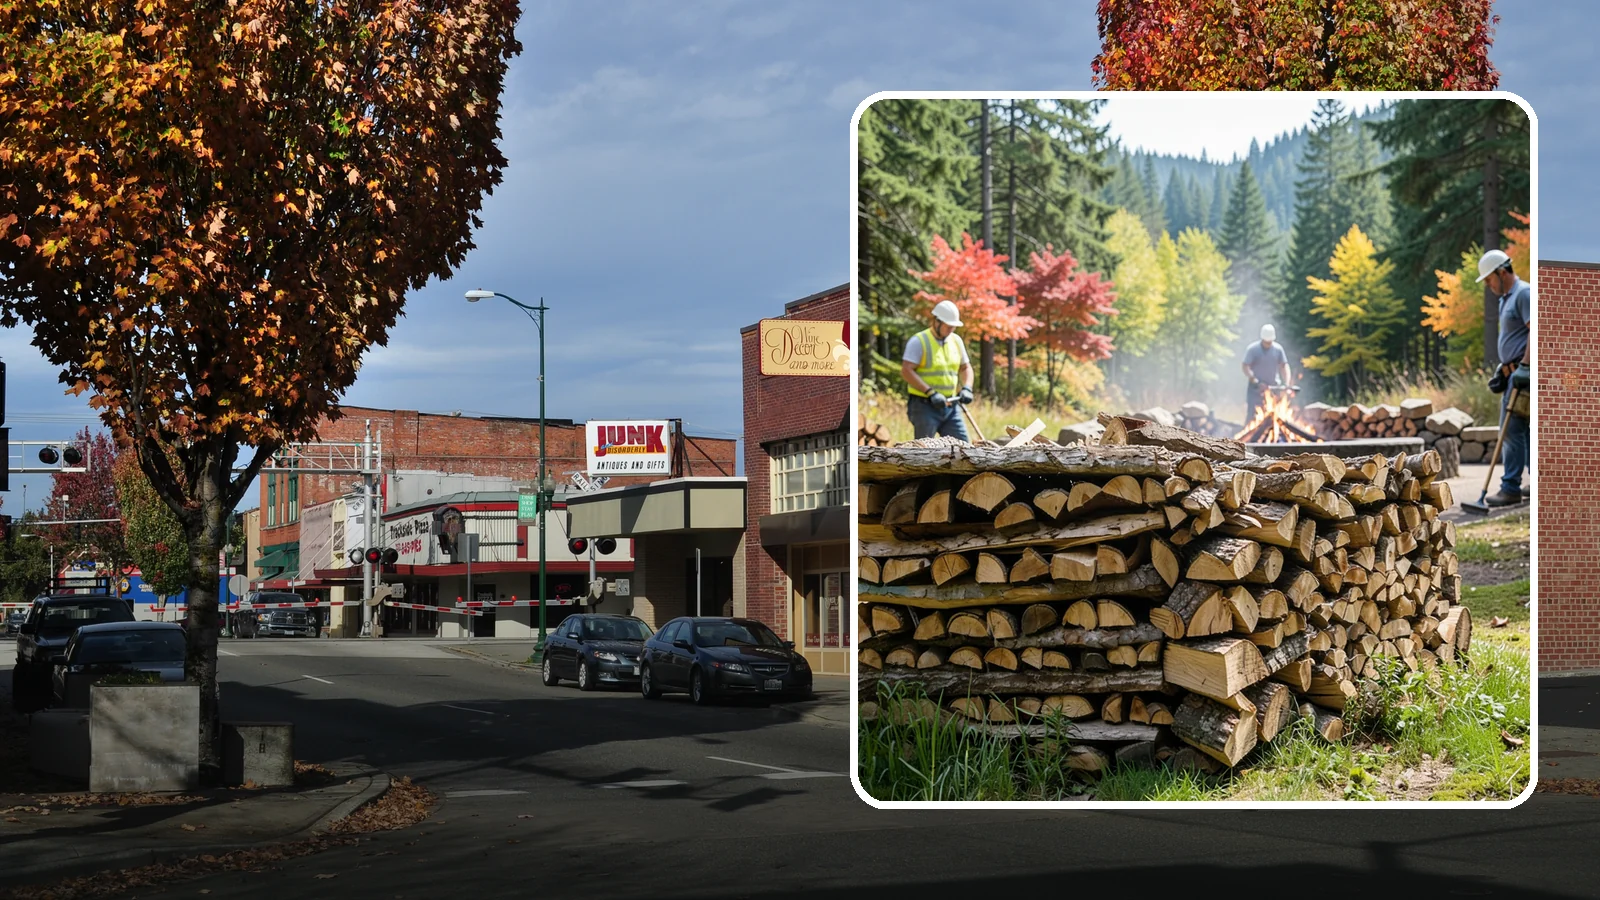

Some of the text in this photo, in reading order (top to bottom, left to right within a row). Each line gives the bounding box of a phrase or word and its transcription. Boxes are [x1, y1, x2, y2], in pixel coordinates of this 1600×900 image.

[596, 425, 664, 457] JUNK
[608, 446, 645, 454] DISORDERLY
[597, 460, 665, 470] ANTIQUES AND GIFTS
[391, 521, 412, 539] Trackside
